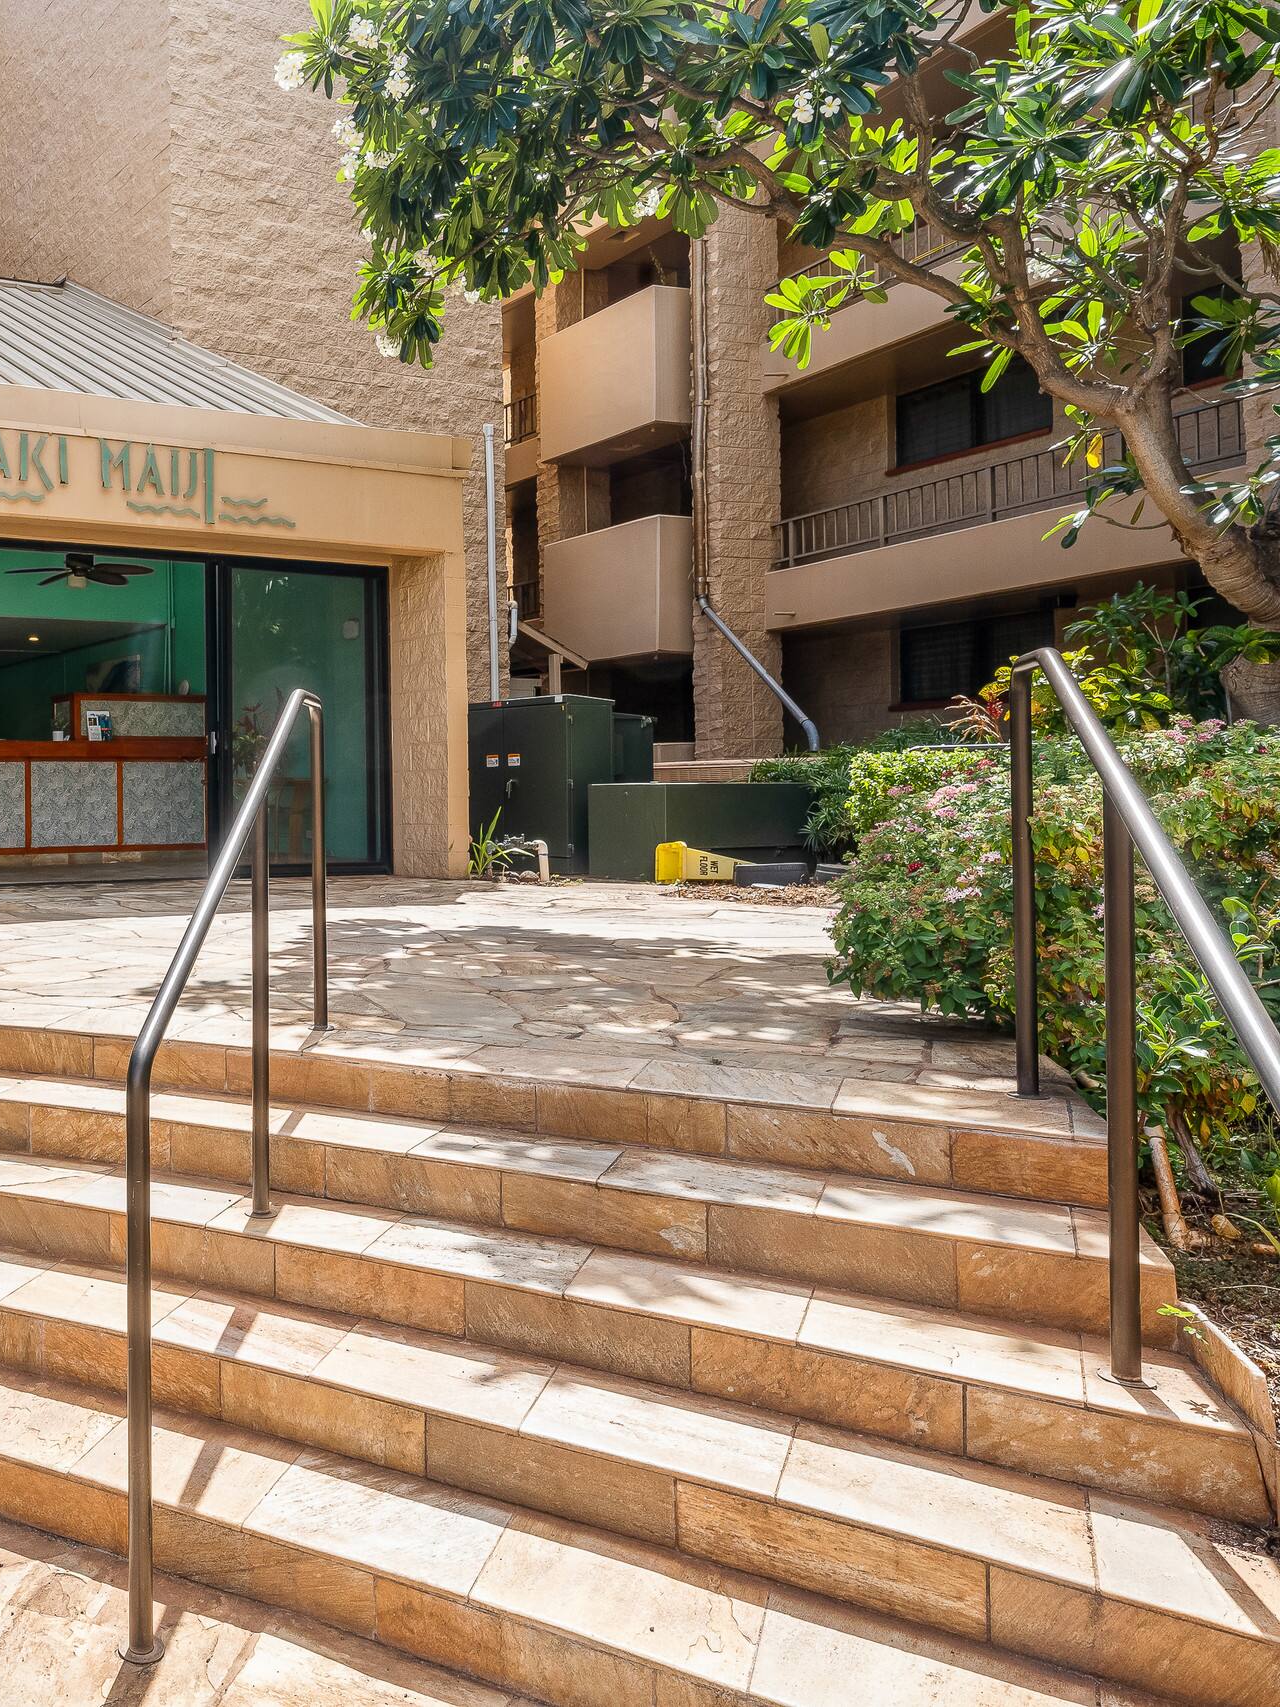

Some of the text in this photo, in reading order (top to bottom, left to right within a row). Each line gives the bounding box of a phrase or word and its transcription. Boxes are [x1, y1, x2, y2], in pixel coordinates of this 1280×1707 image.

[99, 437, 215, 524] MAUI
[699, 855, 708, 876] FLOOR
[710, 860, 718, 874] WET
